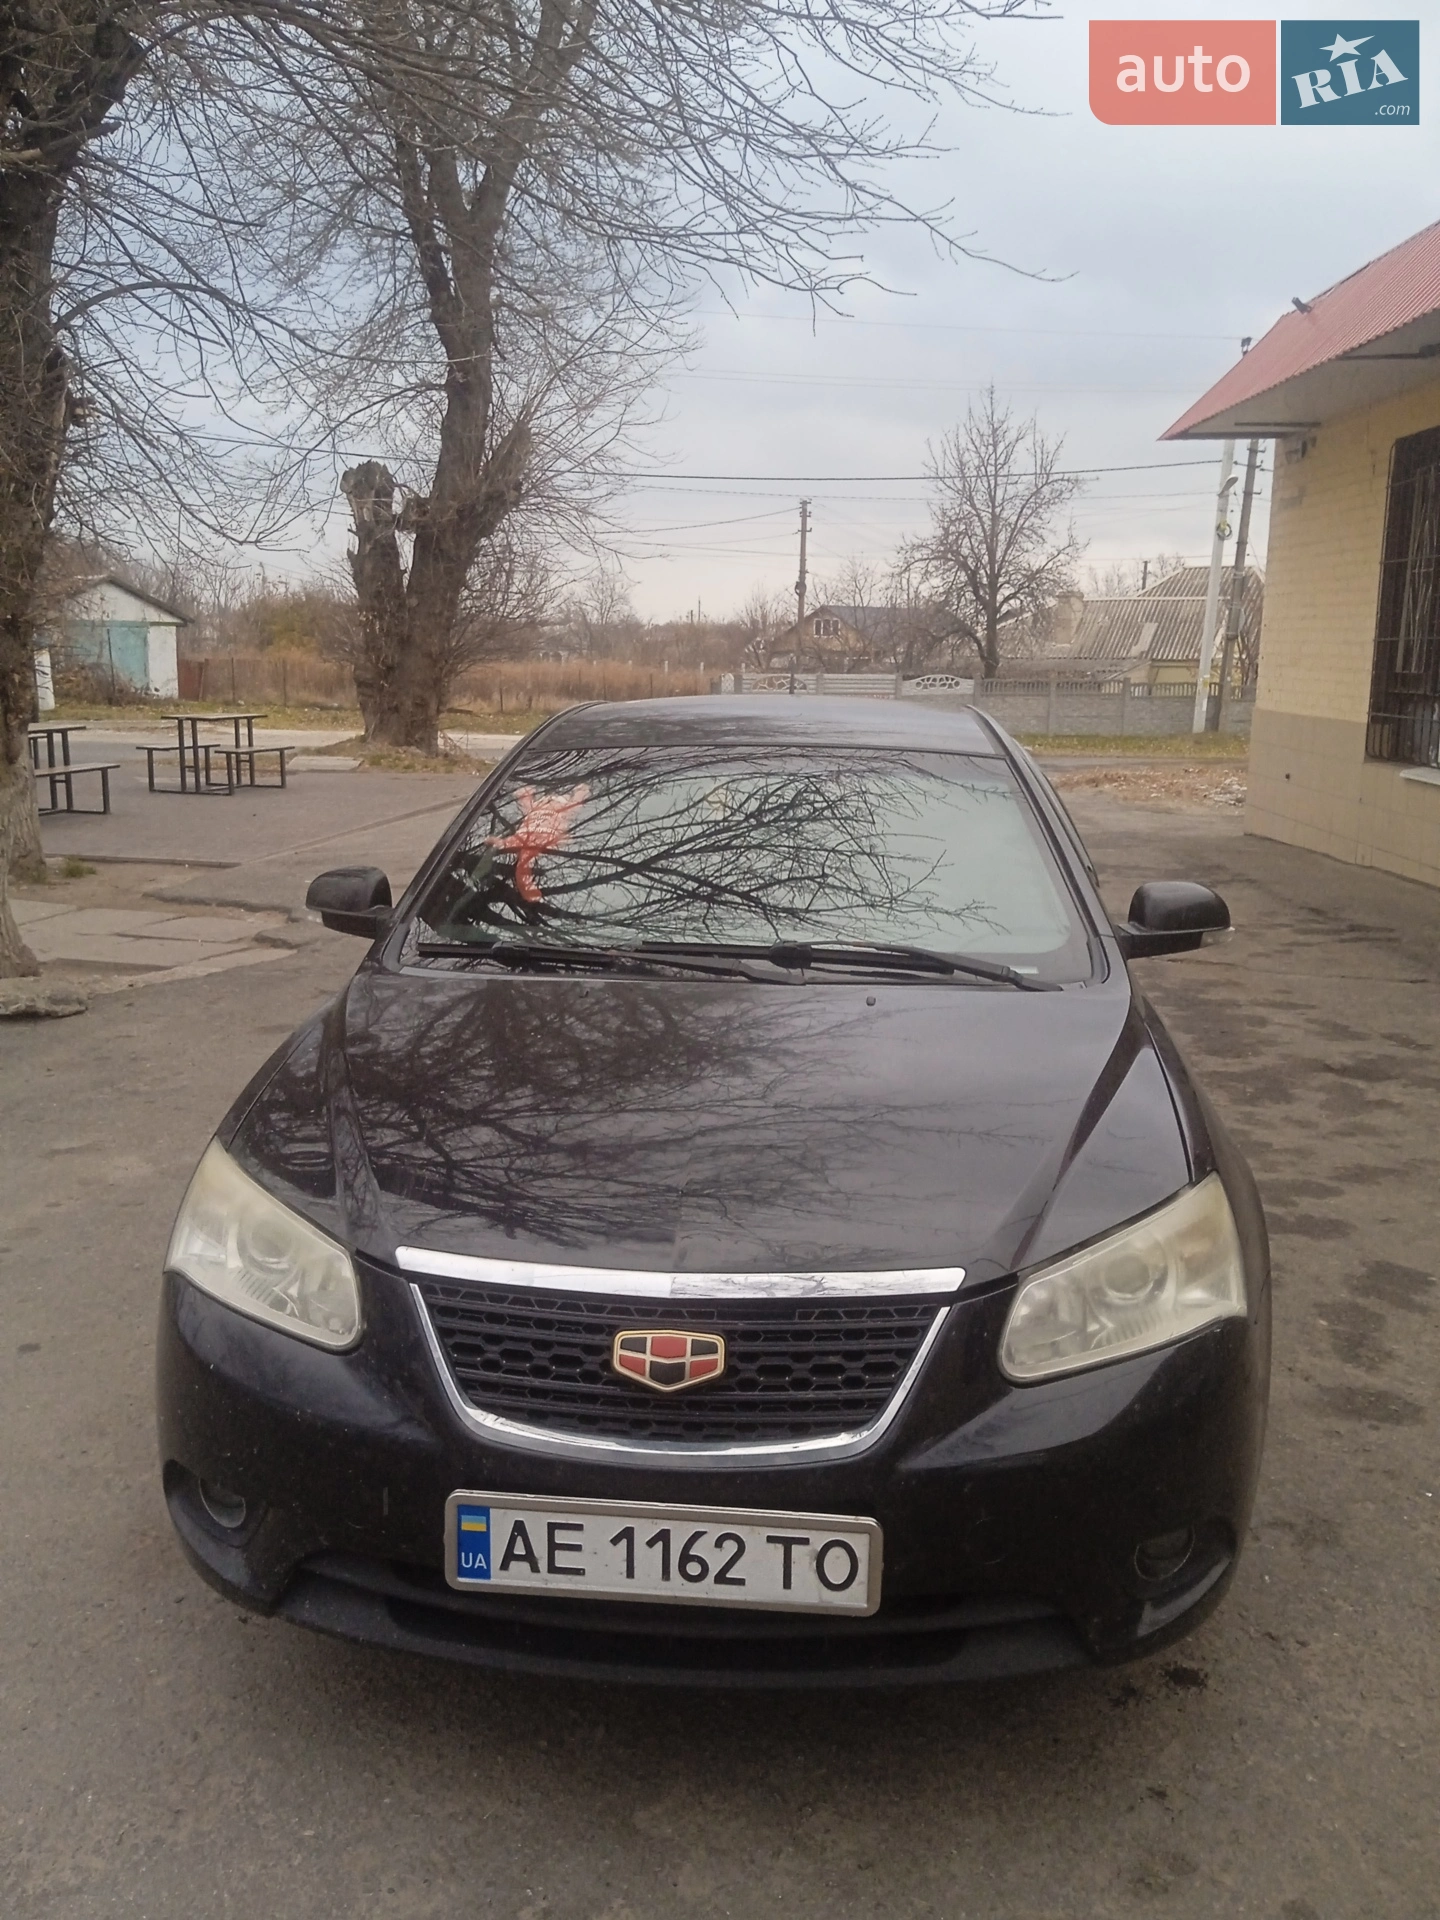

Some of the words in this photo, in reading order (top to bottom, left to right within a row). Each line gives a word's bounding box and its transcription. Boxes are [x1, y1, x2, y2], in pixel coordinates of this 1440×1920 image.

[460, 1551, 488, 1570] UA
[499, 1518, 587, 1577] AE
[608, 1525, 747, 1587] 1162
[765, 1534, 860, 1592] TO
